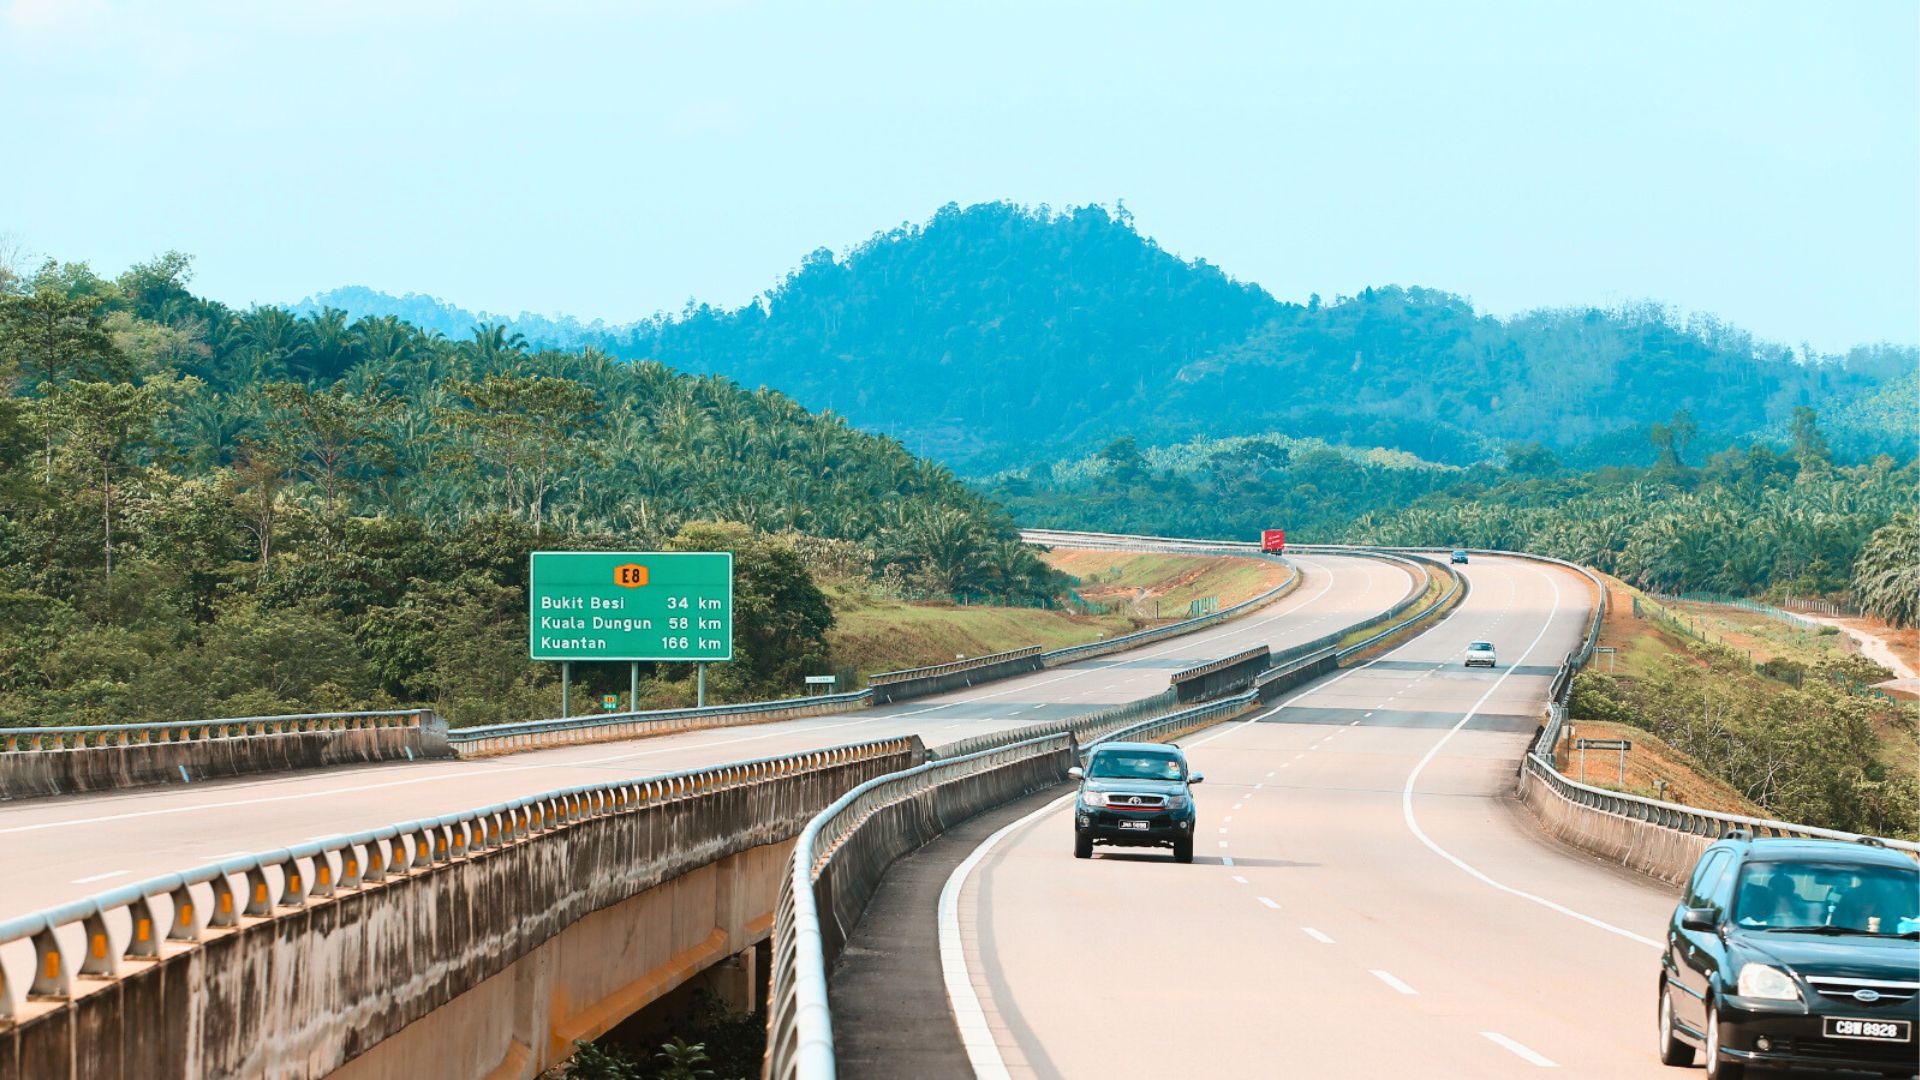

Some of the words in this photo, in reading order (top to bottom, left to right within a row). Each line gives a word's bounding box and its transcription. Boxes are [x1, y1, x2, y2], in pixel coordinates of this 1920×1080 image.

[622, 568, 640, 583] E8
[542, 597, 583, 609] Bukit
[591, 597, 624, 609] Besi
[667, 598, 688, 609] 34
[699, 598, 721, 609] km
[542, 617, 585, 629] Kuala
[593, 617, 651, 632] Dungun
[669, 618, 688, 629] 58
[699, 618, 721, 629] km
[542, 637, 606, 649] Kuantan
[662, 637, 688, 649] 166
[699, 637, 721, 649] km
[1863, 1022, 1897, 1037] 8928
